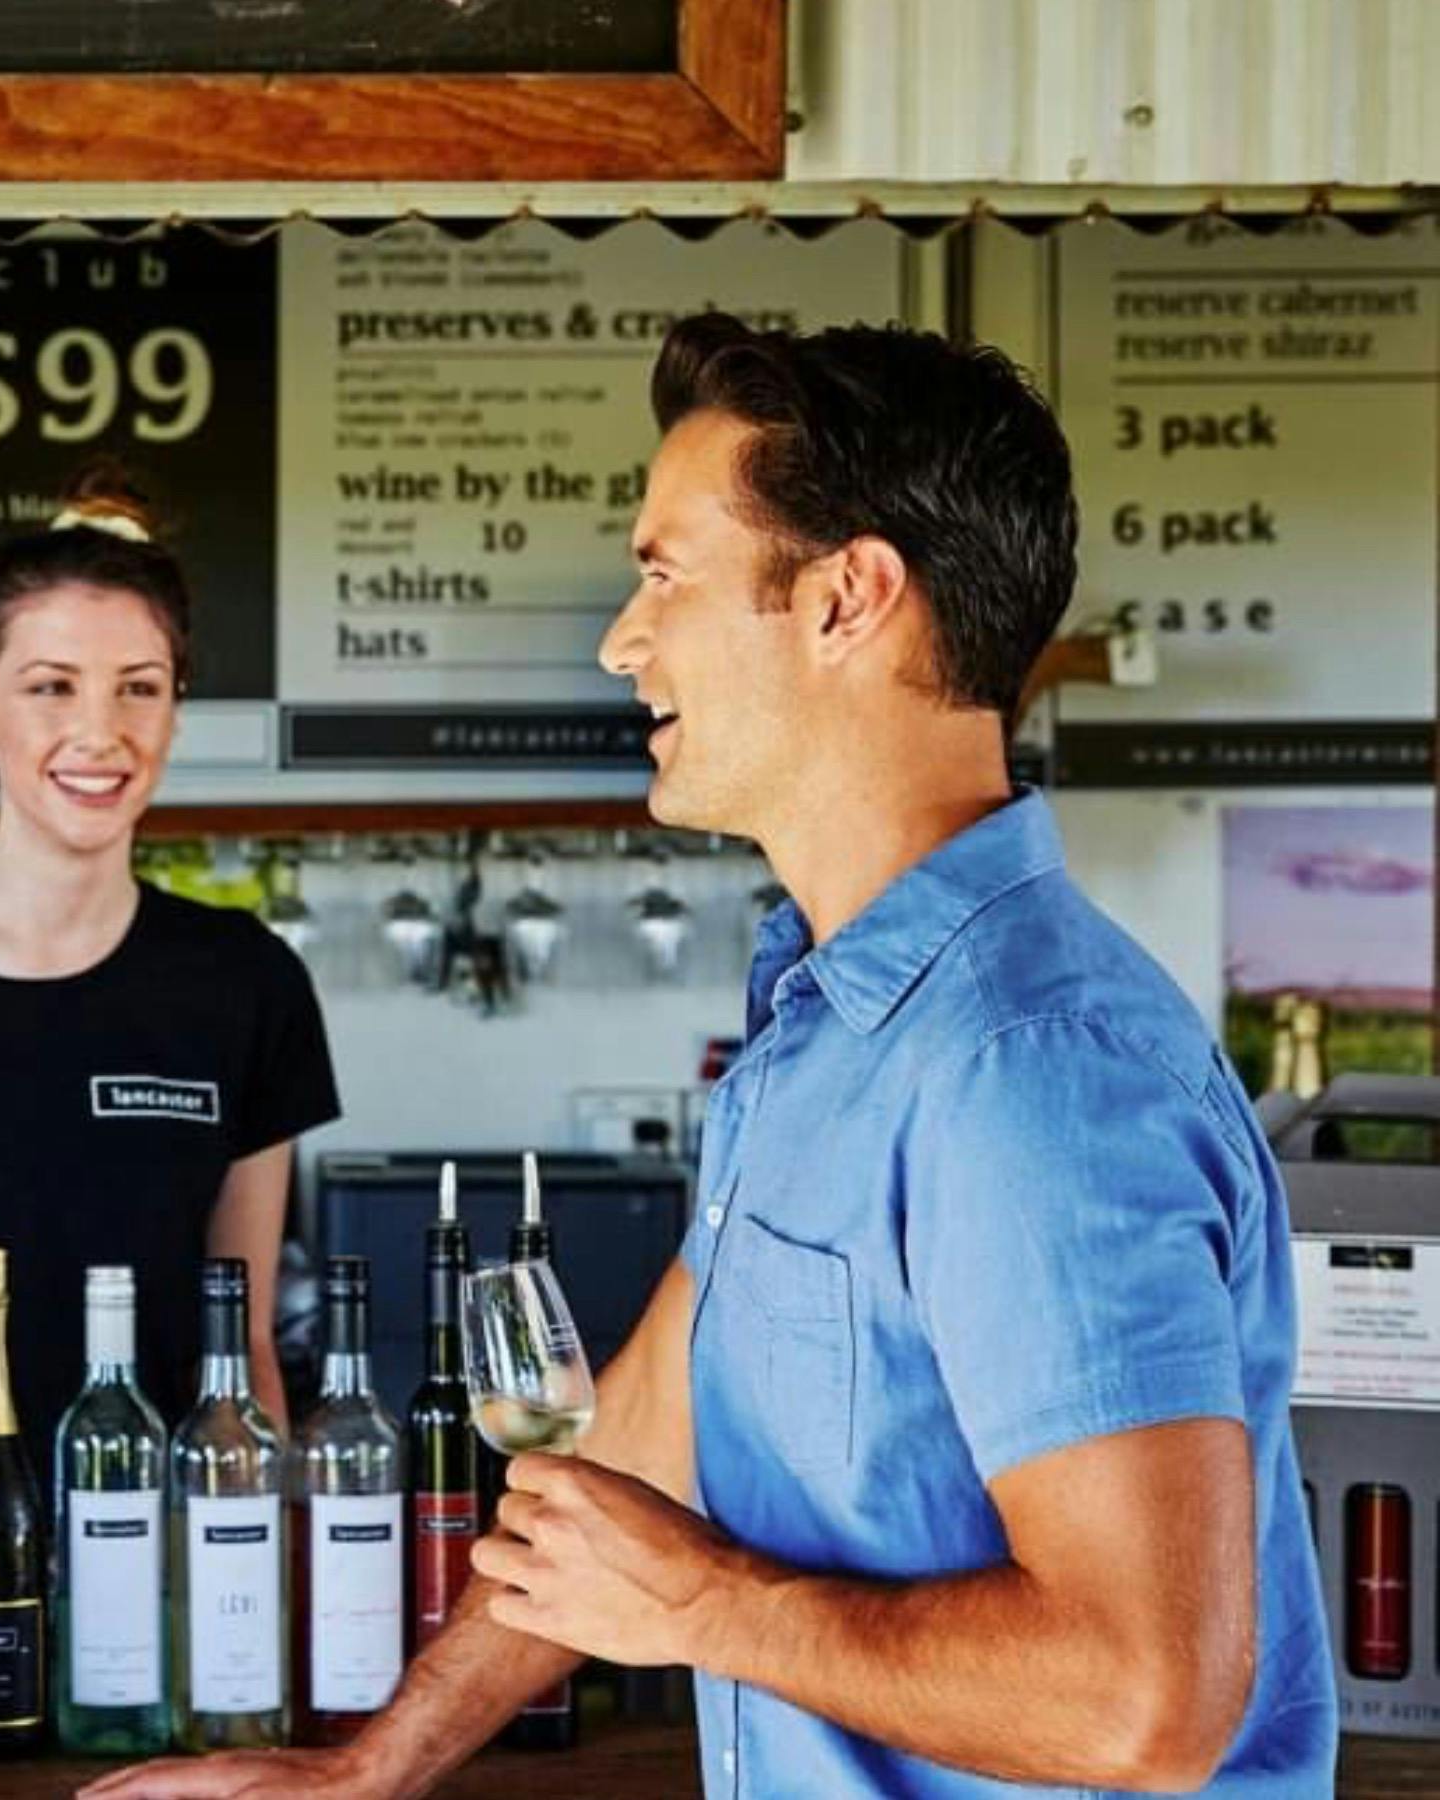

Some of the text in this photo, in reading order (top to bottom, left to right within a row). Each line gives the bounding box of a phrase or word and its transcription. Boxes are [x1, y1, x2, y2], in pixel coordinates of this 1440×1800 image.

[336, 305, 553, 348] preserves
[566, 302, 599, 341] &
[1115, 402, 1277, 458] 3 pack
[336, 462, 650, 510] wine by the gl
[481, 519, 528, 555] 10
[1112, 500, 1277, 555] 6 pack
[336, 563, 490, 603] t-shirts
[1112, 600, 1274, 634] case
[336, 620, 429, 659] hats
